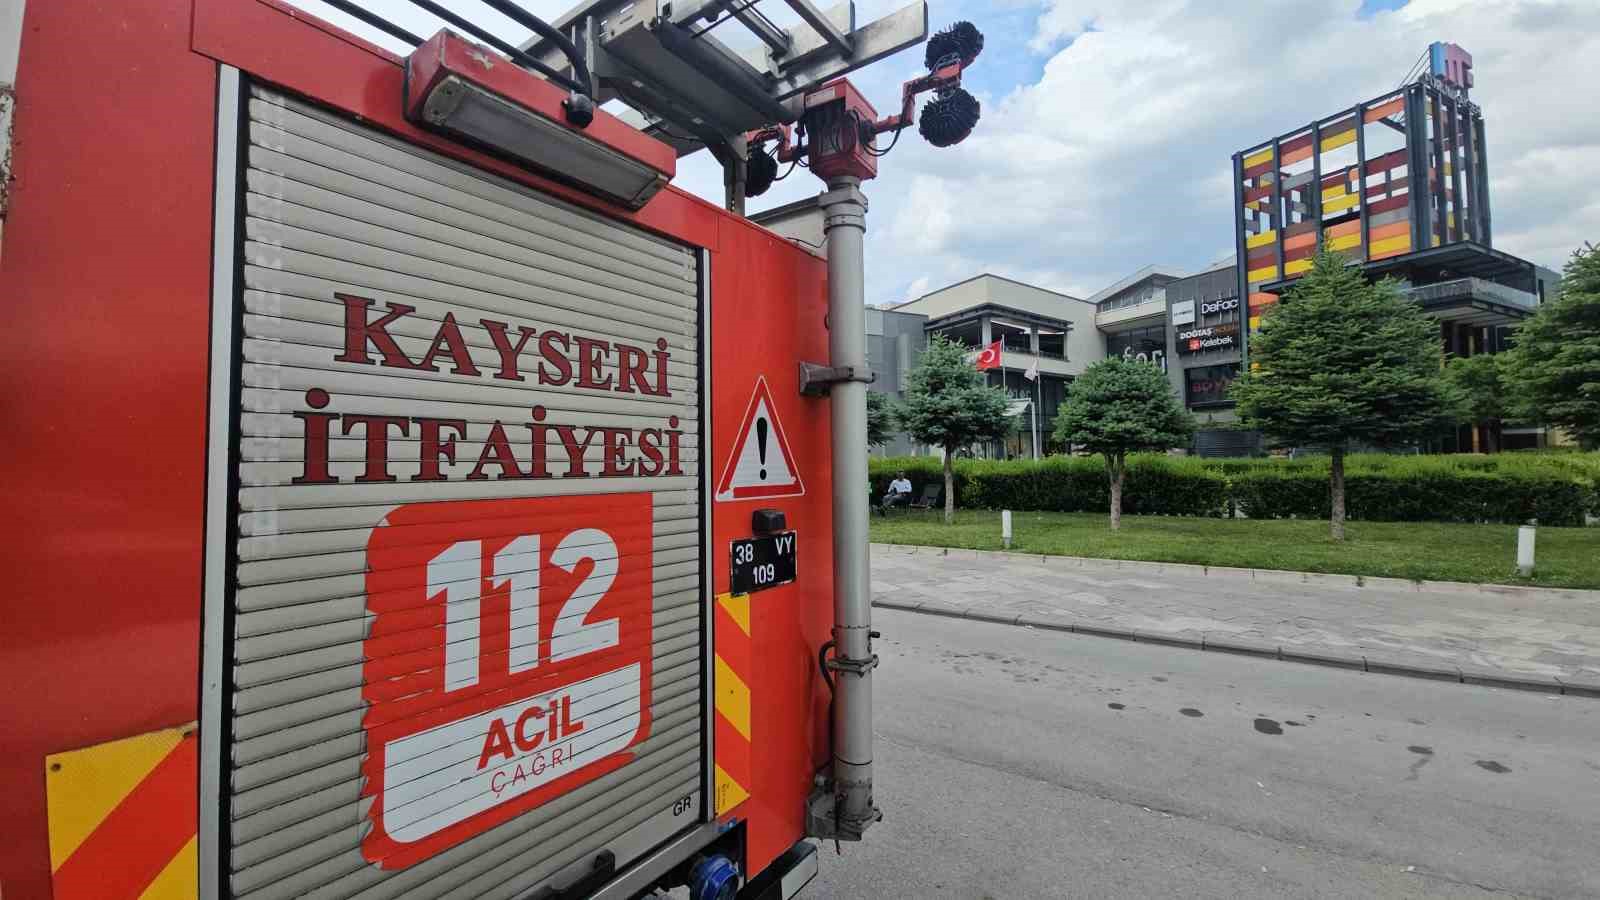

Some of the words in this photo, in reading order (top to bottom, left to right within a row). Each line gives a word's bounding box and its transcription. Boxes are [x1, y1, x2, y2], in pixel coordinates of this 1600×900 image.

[334, 292, 672, 398] KAYSERİ
[1200, 335, 1233, 348] Kelebek
[292, 387, 684, 485] İTFAİYESİ
[736, 543, 754, 565] 38
[775, 536, 793, 556] VY
[752, 563, 775, 585] 109
[425, 527, 620, 694] 112
[491, 743, 574, 799] ÇAĞRI
[672, 795, 691, 817] GR
